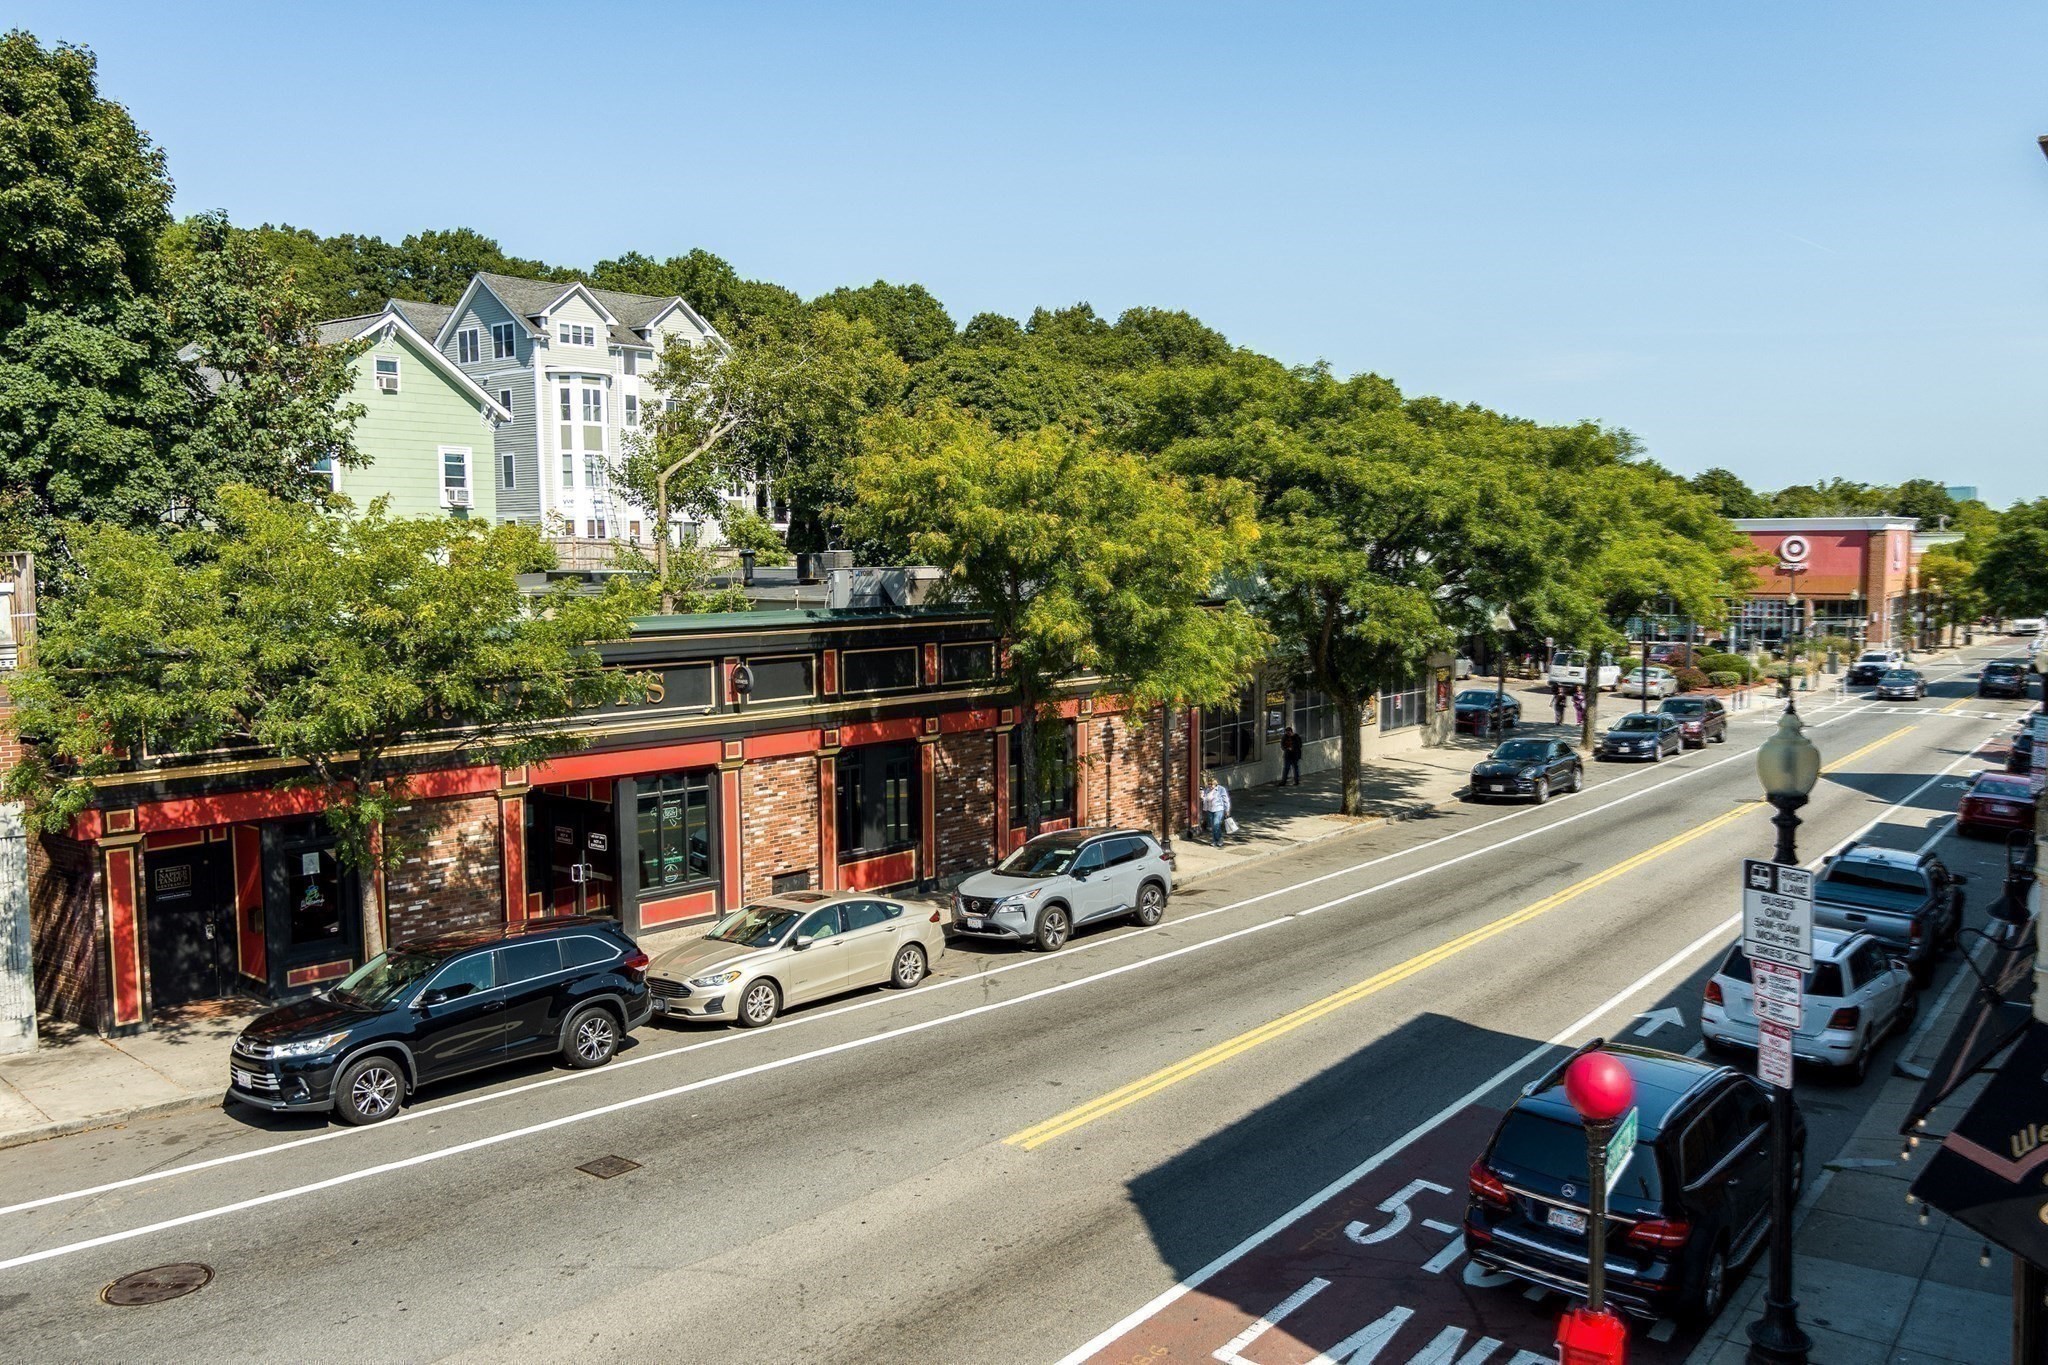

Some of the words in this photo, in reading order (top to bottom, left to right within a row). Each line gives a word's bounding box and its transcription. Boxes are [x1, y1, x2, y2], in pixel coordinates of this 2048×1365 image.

[1780, 870, 1809, 883] RIGHT
[1782, 882, 1808, 896] LANE
[1761, 895, 1795, 910] BUSES
[1764, 907, 1790, 920] ONLY
[1755, 944, 1782, 959] BIKES
